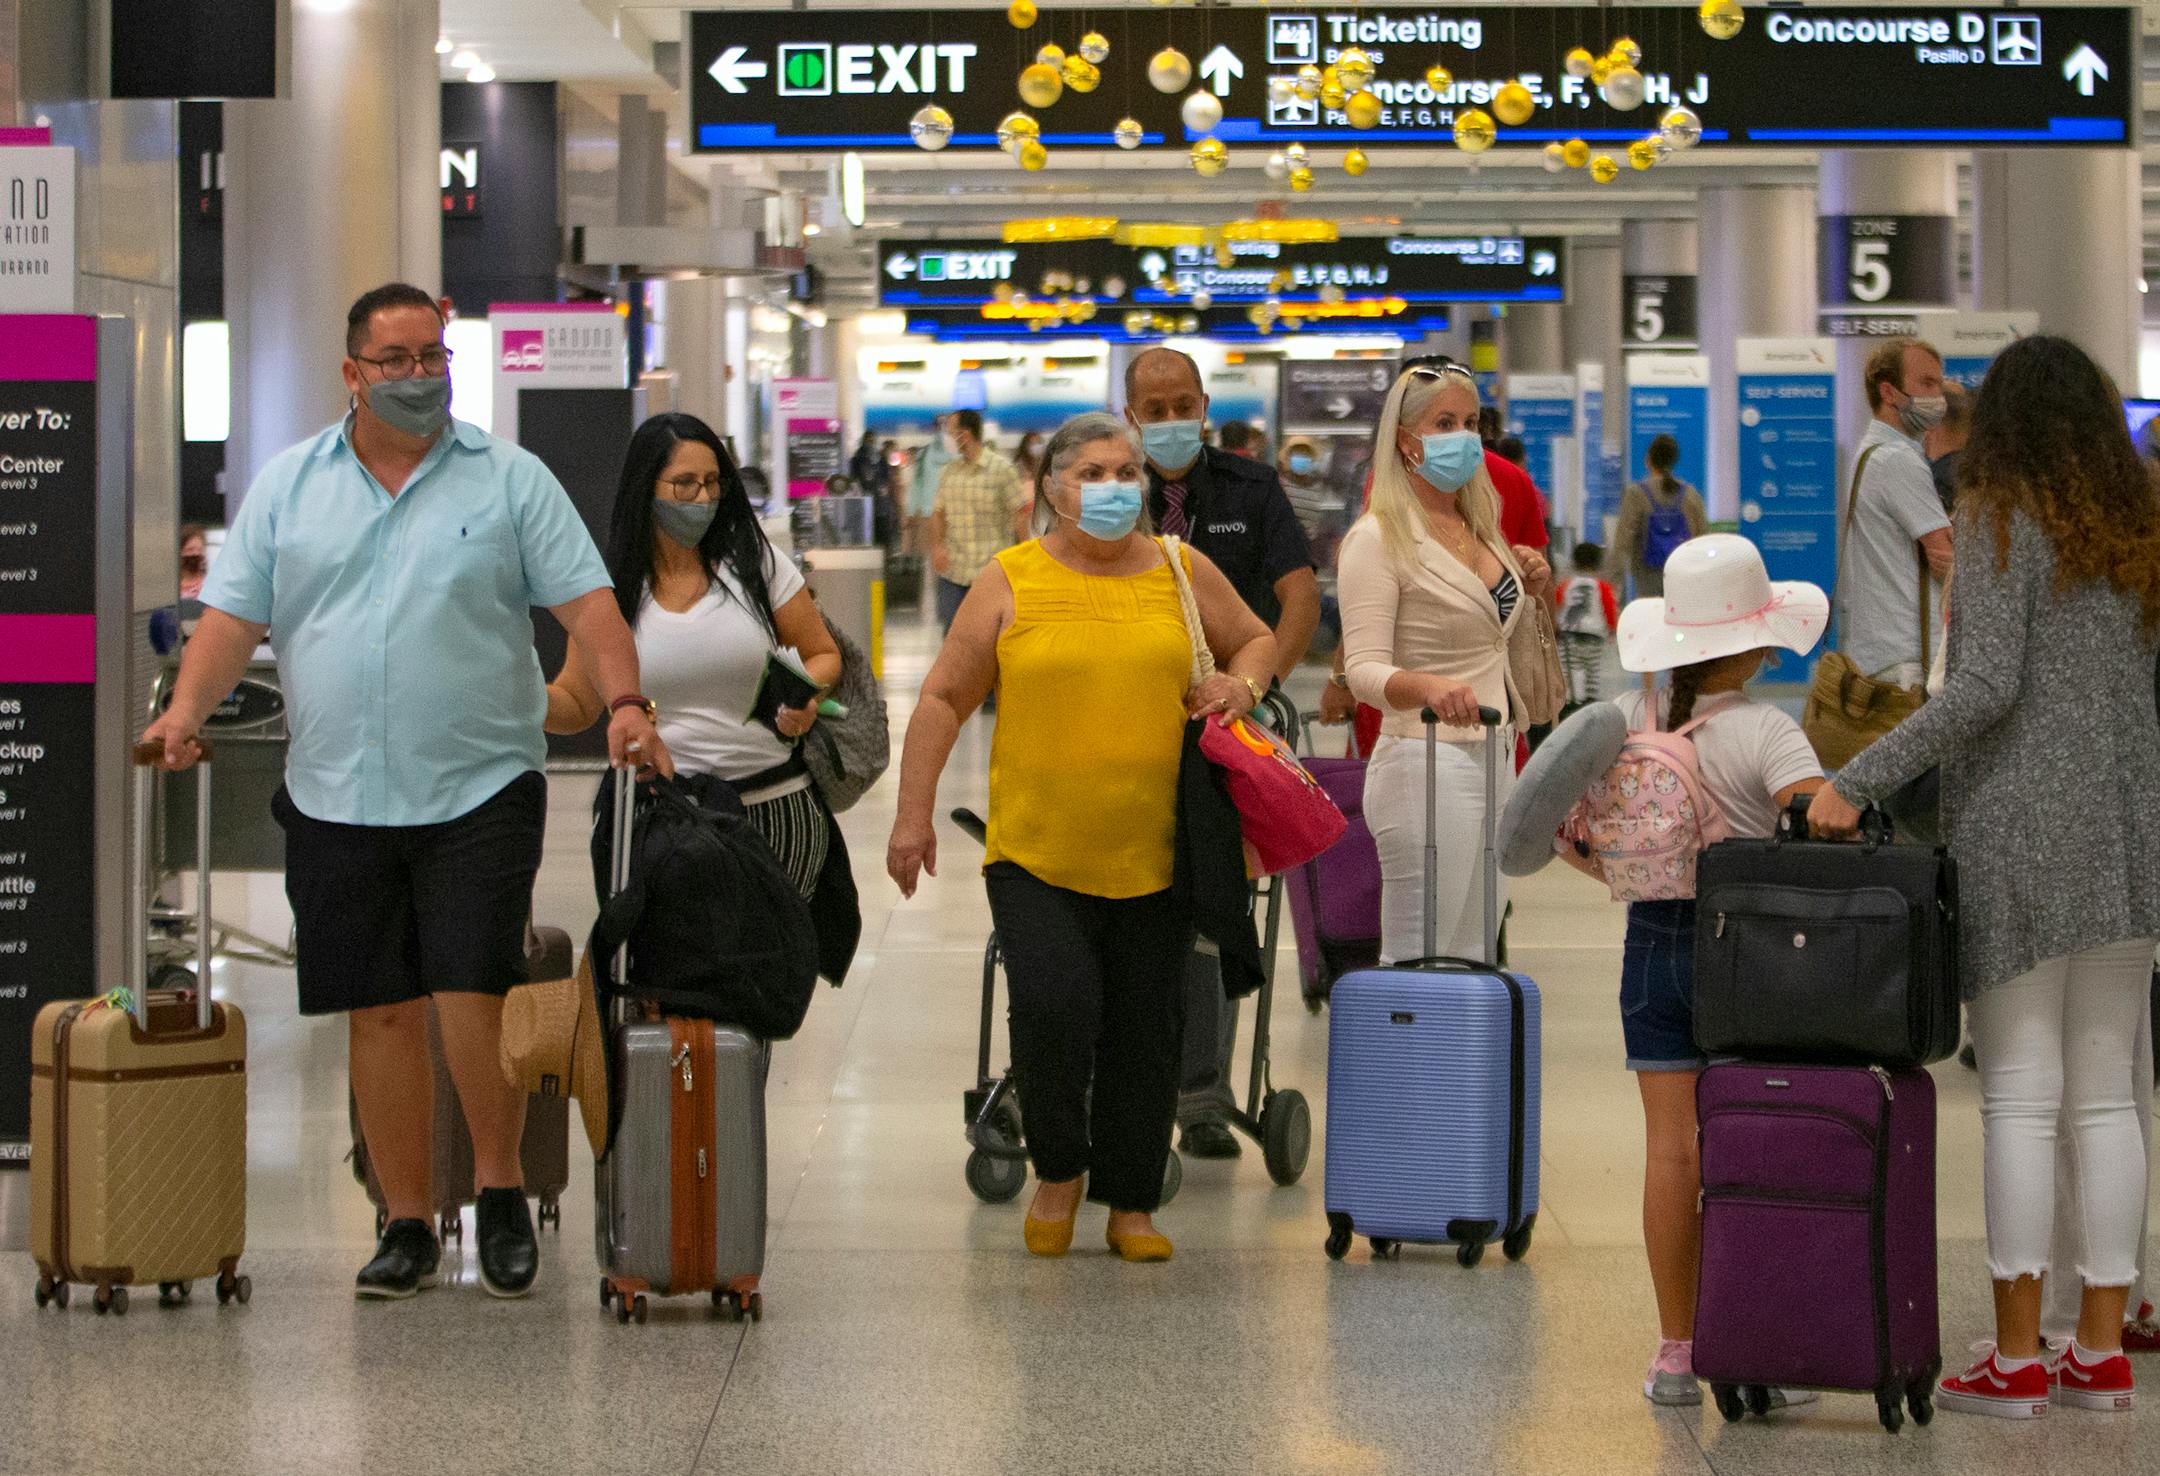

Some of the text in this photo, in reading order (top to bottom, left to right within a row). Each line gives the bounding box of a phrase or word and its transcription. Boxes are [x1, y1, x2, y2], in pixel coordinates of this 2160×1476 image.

[1327, 15, 1481, 49] Ticketing
[1769, 15, 1984, 42] Concourse D
[1919, 48, 1985, 64] Pasillo D
[837, 44, 977, 93] EXIT
[1344, 76, 1505, 105] ncours
[1687, 75, 1708, 103] J
[1853, 221, 1897, 236] ZONE
[948, 252, 1016, 280] EXIT
[1852, 241, 1891, 301] 5
[1636, 297, 1664, 341] 5
[1372, 368, 1389, 392] 3
[36, 409, 70, 430] To:
[0, 455, 63, 473] Center
[29, 477, 38, 490] 3
[29, 522, 38, 535] 3
[1208, 521, 1247, 534] envoy
[29, 568, 38, 581] 3
[19, 718, 25, 730] 1
[18, 763, 24, 775] 1
[20, 808, 26, 820] 1
[20, 852, 26, 864] 1
[18, 897, 27, 910] 3
[18, 941, 27, 953] 3
[18, 985, 27, 998] 3
